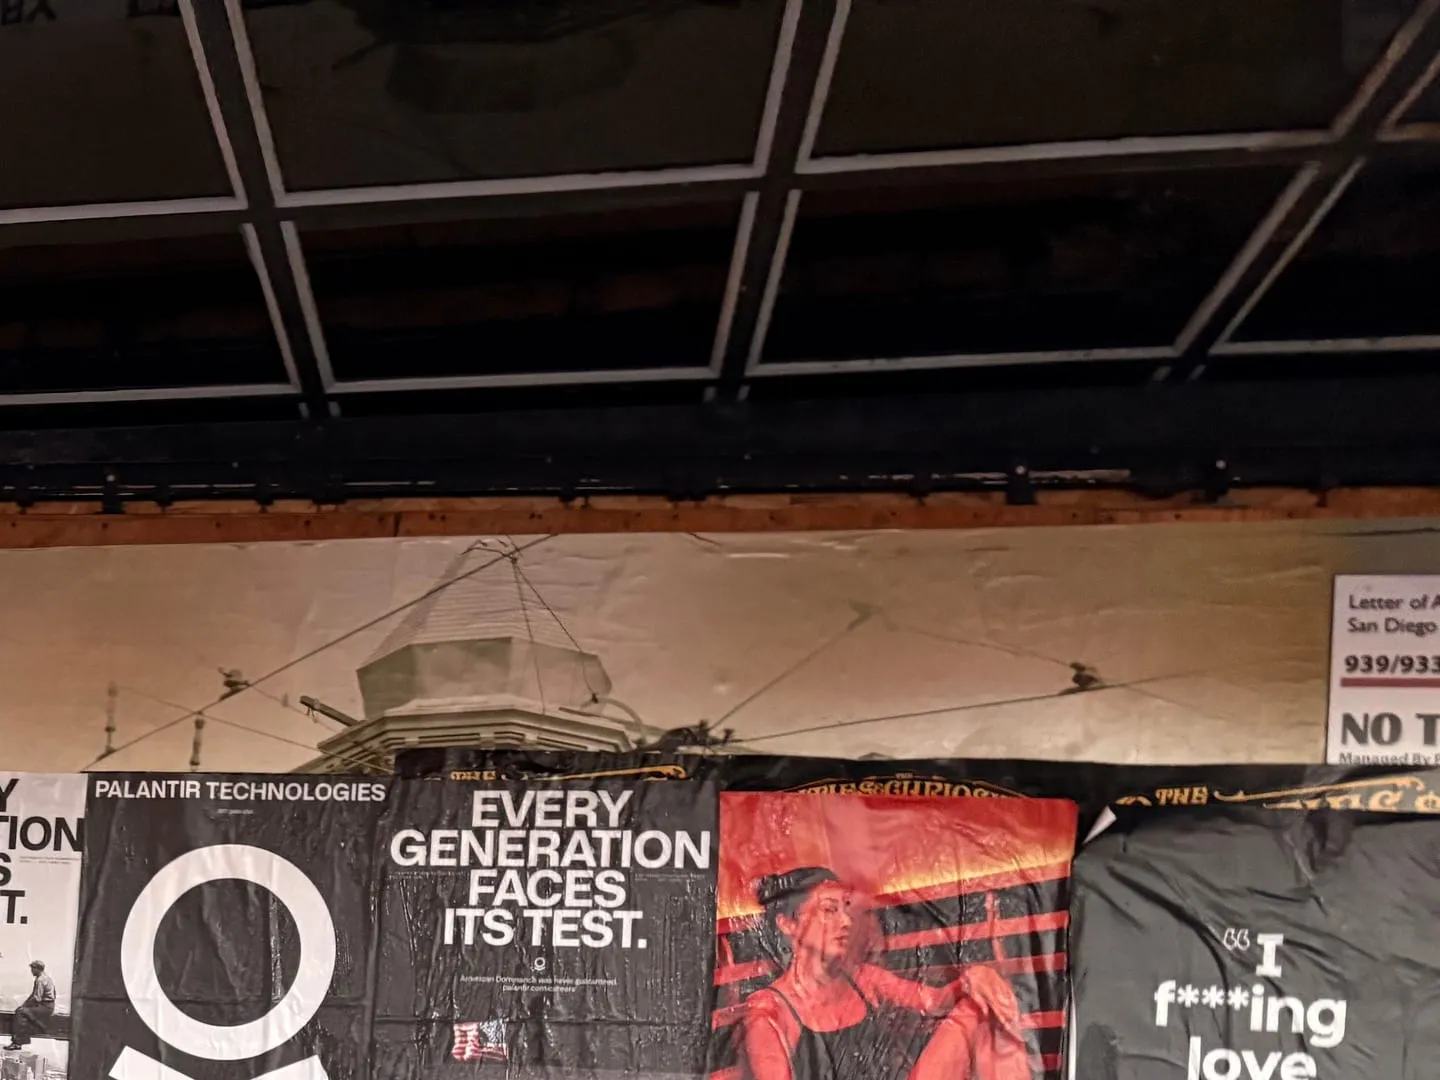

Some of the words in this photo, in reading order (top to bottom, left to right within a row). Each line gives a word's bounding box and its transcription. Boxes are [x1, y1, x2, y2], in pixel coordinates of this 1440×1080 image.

[1348, 594, 1402, 610] Letter
[1409, 594, 1428, 610] of
[1347, 617, 1378, 633] San
[1384, 617, 1438, 637] Diego
[1340, 712, 1402, 746] NO
[96, 781, 200, 798] PALANTIR
[206, 782, 385, 801] TECHNOLOGIES
[472, 790, 633, 827] EVERY
[391, 830, 710, 868] GENERATION
[469, 869, 626, 907] FACES
[444, 908, 515, 945] ITS
[524, 907, 646, 948] TEST.
